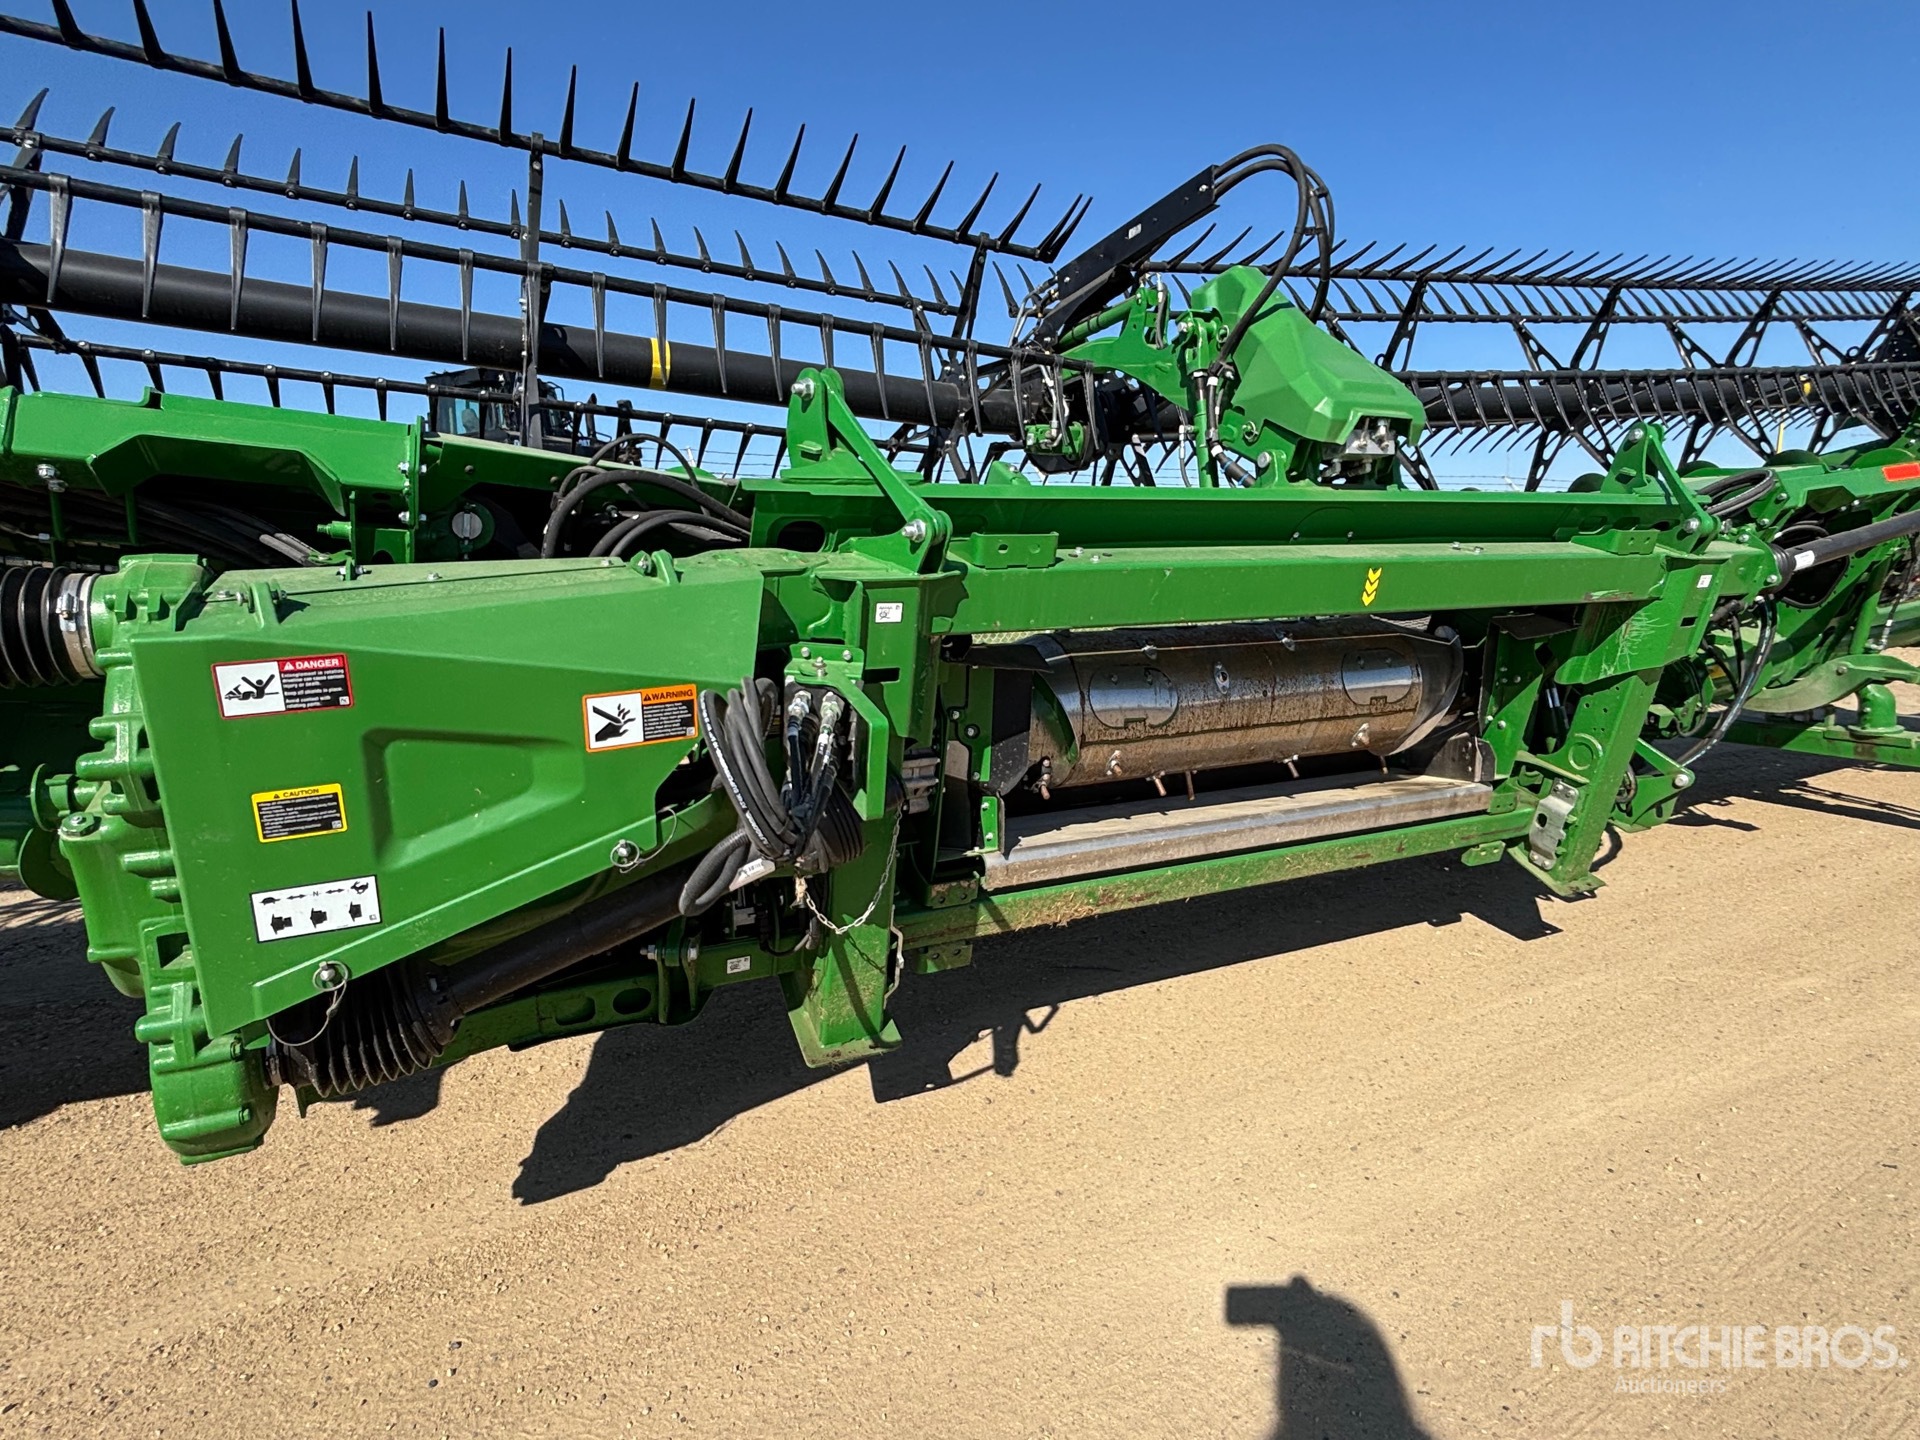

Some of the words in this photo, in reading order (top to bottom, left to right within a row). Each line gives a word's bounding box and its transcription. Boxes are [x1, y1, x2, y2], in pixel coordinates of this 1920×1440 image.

[295, 658, 339, 670] DANGER
[651, 689, 693, 701] WARNING
[282, 788, 320, 798] CAUTION
